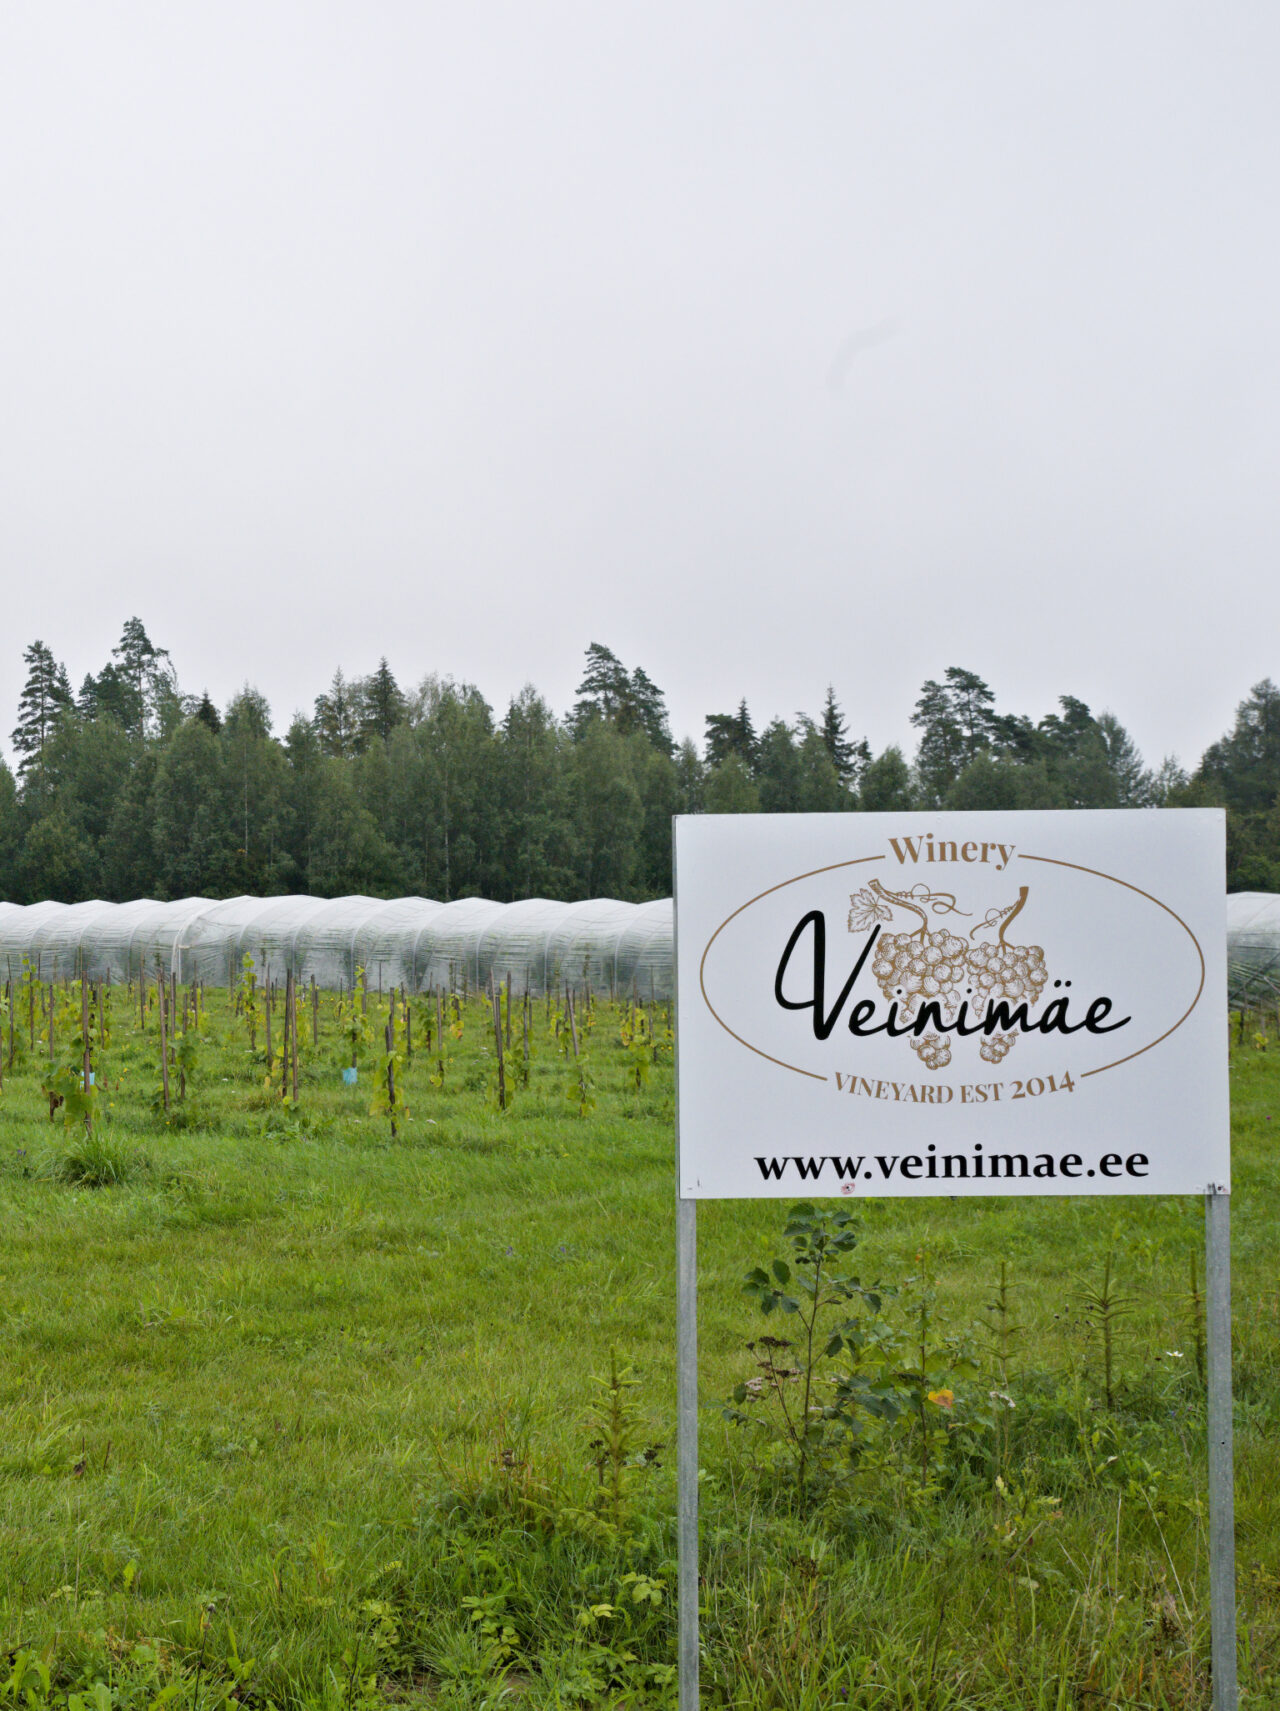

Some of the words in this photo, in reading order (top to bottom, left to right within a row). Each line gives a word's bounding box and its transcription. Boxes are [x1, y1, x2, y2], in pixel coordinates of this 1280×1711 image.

[888, 832, 1016, 871] Winery
[773, 909, 1132, 1041] Veinimäe
[832, 1070, 955, 1104] VINEYARD
[960, 1082, 1004, 1103] EST
[1010, 1070, 1076, 1100] 2014
[753, 1143, 1150, 1180] www.veinimae.ee
